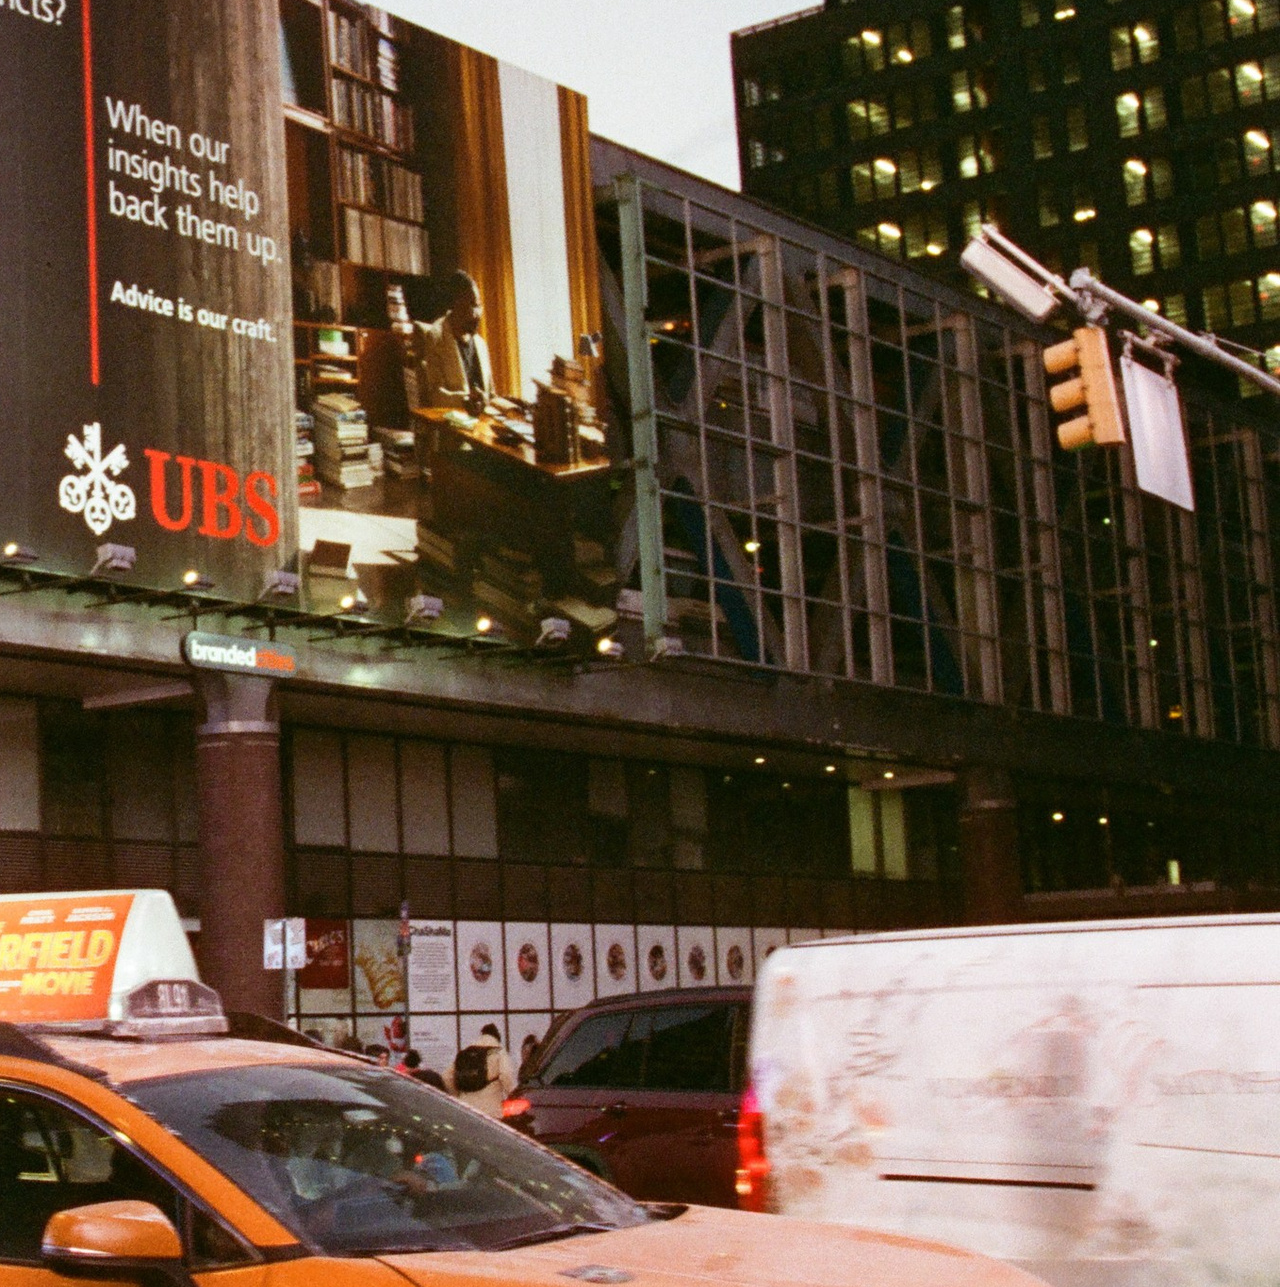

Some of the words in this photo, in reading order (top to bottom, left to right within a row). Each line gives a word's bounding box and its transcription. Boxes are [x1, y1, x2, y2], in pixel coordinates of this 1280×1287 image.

[106, 95, 181, 150] When
[190, 131, 230, 164] our
[108, 139, 202, 199] insights
[209, 170, 259, 220] help
[108, 181, 168, 230] back
[177, 204, 239, 252] them
[247, 234, 283, 266] up.
[110, 280, 174, 318] Advice
[178, 297, 193, 320] is
[197, 305, 228, 331] our
[231, 309, 278, 343] craft.
[143, 448, 280, 547] UBS
[20, 971, 96, 996] MOVIE
